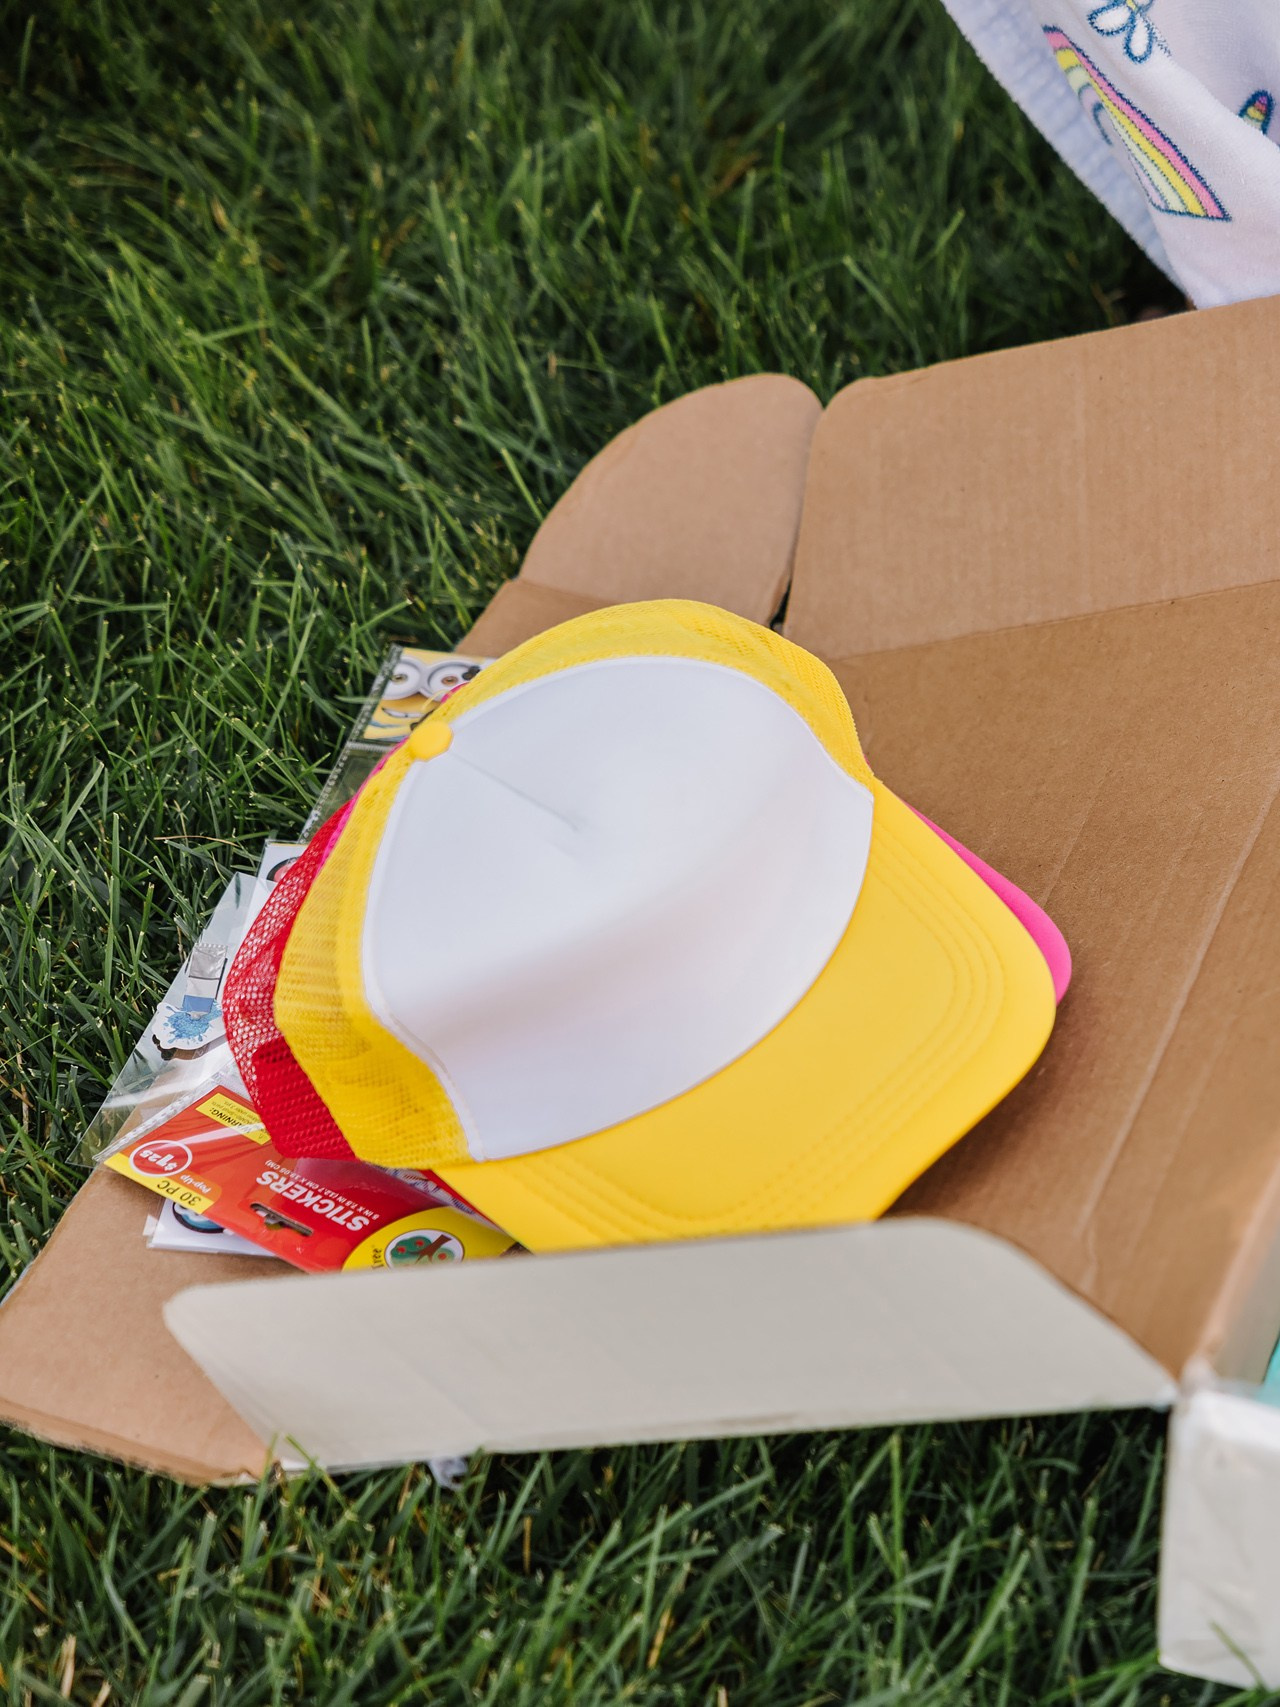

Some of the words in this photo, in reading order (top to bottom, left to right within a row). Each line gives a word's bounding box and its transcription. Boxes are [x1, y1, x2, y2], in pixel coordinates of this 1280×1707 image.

[156, 1180, 180, 1195] PC
[180, 1174, 211, 1194] Pop-Up
[179, 1191, 202, 1207] 30
[255, 1170, 370, 1232] STICKERS
